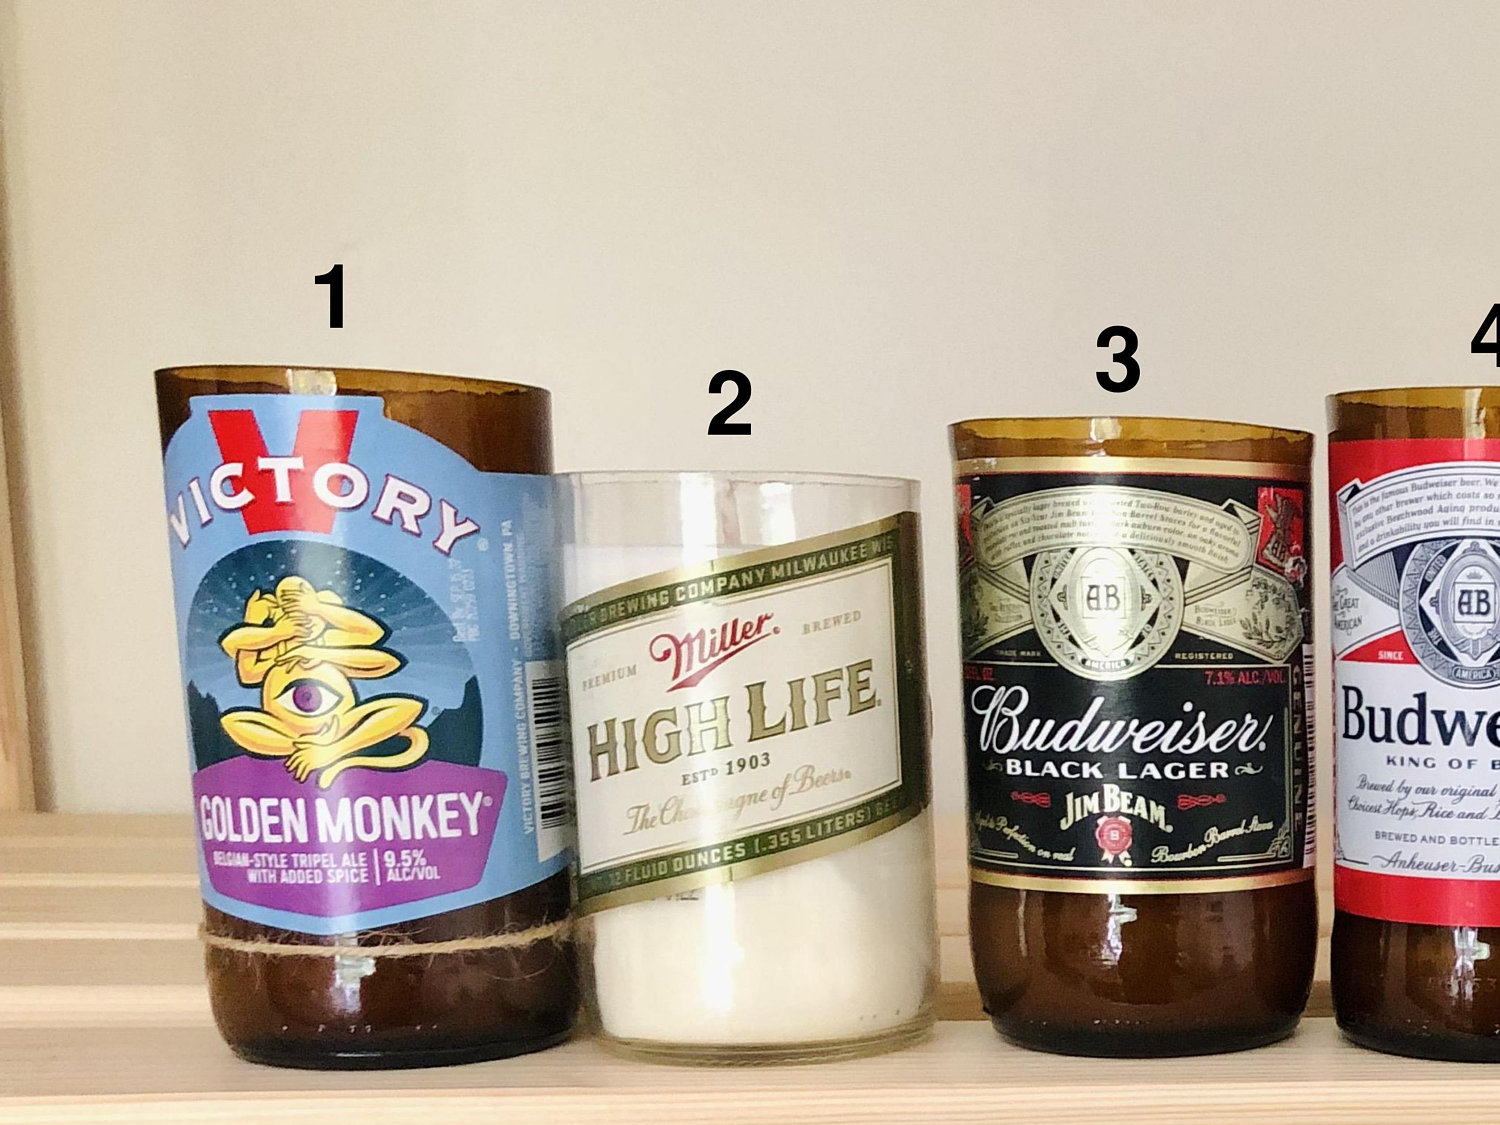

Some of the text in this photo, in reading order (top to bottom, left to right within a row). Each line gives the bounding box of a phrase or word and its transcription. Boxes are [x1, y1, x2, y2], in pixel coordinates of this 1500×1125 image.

[1411, 480, 1458, 492] Budweiser
[1426, 490, 1454, 502] which
[170, 456, 481, 556] VICTORY
[1387, 505, 1434, 526] Beechwood
[675, 543, 868, 602] COMPANY MILWAUKEE
[1458, 589, 1491, 616] AB
[802, 610, 863, 635] BREWED
[649, 612, 774, 685] Miller
[1174, 652, 1234, 661] REGISTERED
[1378, 651, 1404, 661] SINCE
[582, 664, 638, 692] PREMIUM
[1204, 670, 1236, 686] 7.1%
[1454, 668, 1493, 679] AMERICA
[511, 660, 526, 720] COMPANY
[587, 658, 879, 783] HIGH LIFE
[971, 685, 1275, 754] Budweiser
[515, 722, 531, 780] BREWING
[1385, 754, 1436, 769] KING
[1449, 757, 1478, 770] OF
[726, 752, 771, 776] 1903
[1005, 759, 1230, 780] BLACK LAGER
[1356, 774, 1395, 793] Brewed
[1396, 777, 1413, 797] by
[1414, 784, 1438, 796] our
[1441, 781, 1497, 803] original
[200, 790, 484, 844] GOLDEN MONKEY
[521, 782, 535, 834] VICTORY
[623, 804, 658, 836] The
[1060, 783, 1167, 832] JIM BEAM
[1347, 795, 1382, 814] Choicest
[1413, 800, 1455, 819] Rice
[1457, 806, 1486, 821] and
[625, 861, 668, 883] FLUID
[673, 842, 747, 872] OUNCES
[806, 806, 872, 840] LITERS)
[1374, 830, 1418, 843] BREWED
[1420, 833, 1447, 845] AND
[213, 851, 369, 868] BELGIAN-STYLE TRIPEL ALE
[384, 849, 427, 868] 9.5%
[1151, 843, 1207, 864] Bourbon
[247, 868, 369, 884] WITH ADDED SPICE
[386, 865, 441, 882] ALC/VOL
